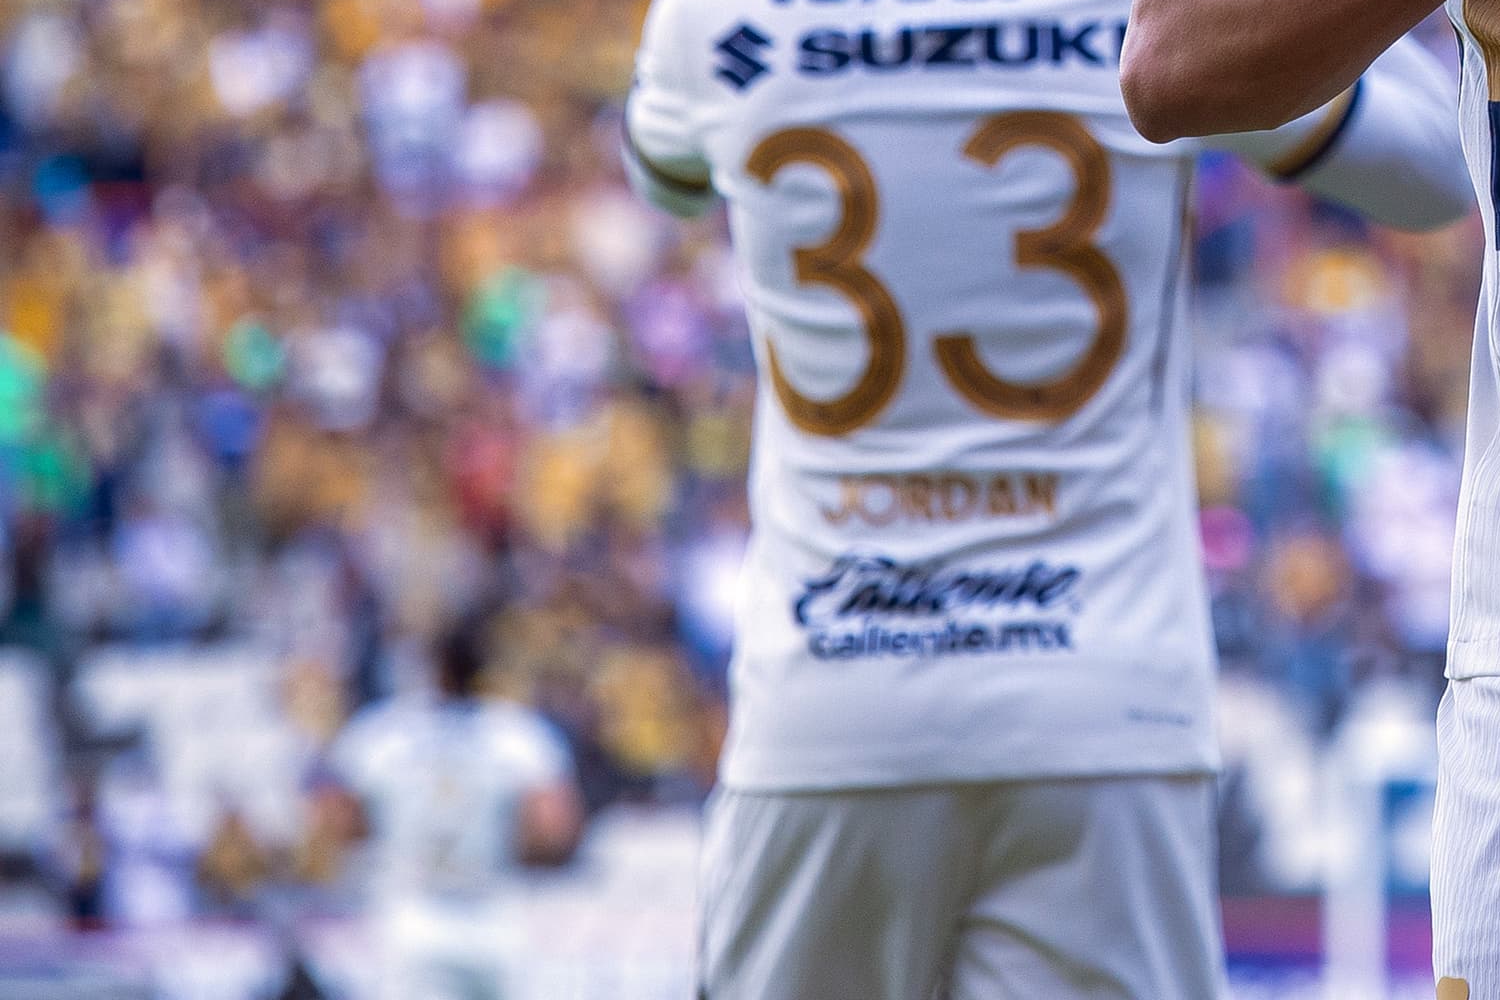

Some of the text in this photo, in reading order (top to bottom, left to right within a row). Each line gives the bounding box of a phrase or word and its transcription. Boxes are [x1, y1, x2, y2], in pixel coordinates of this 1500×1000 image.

[797, 21, 1126, 73] SUZUKI
[745, 109, 1130, 437] 33
[821, 473, 1062, 526] JORDAN
